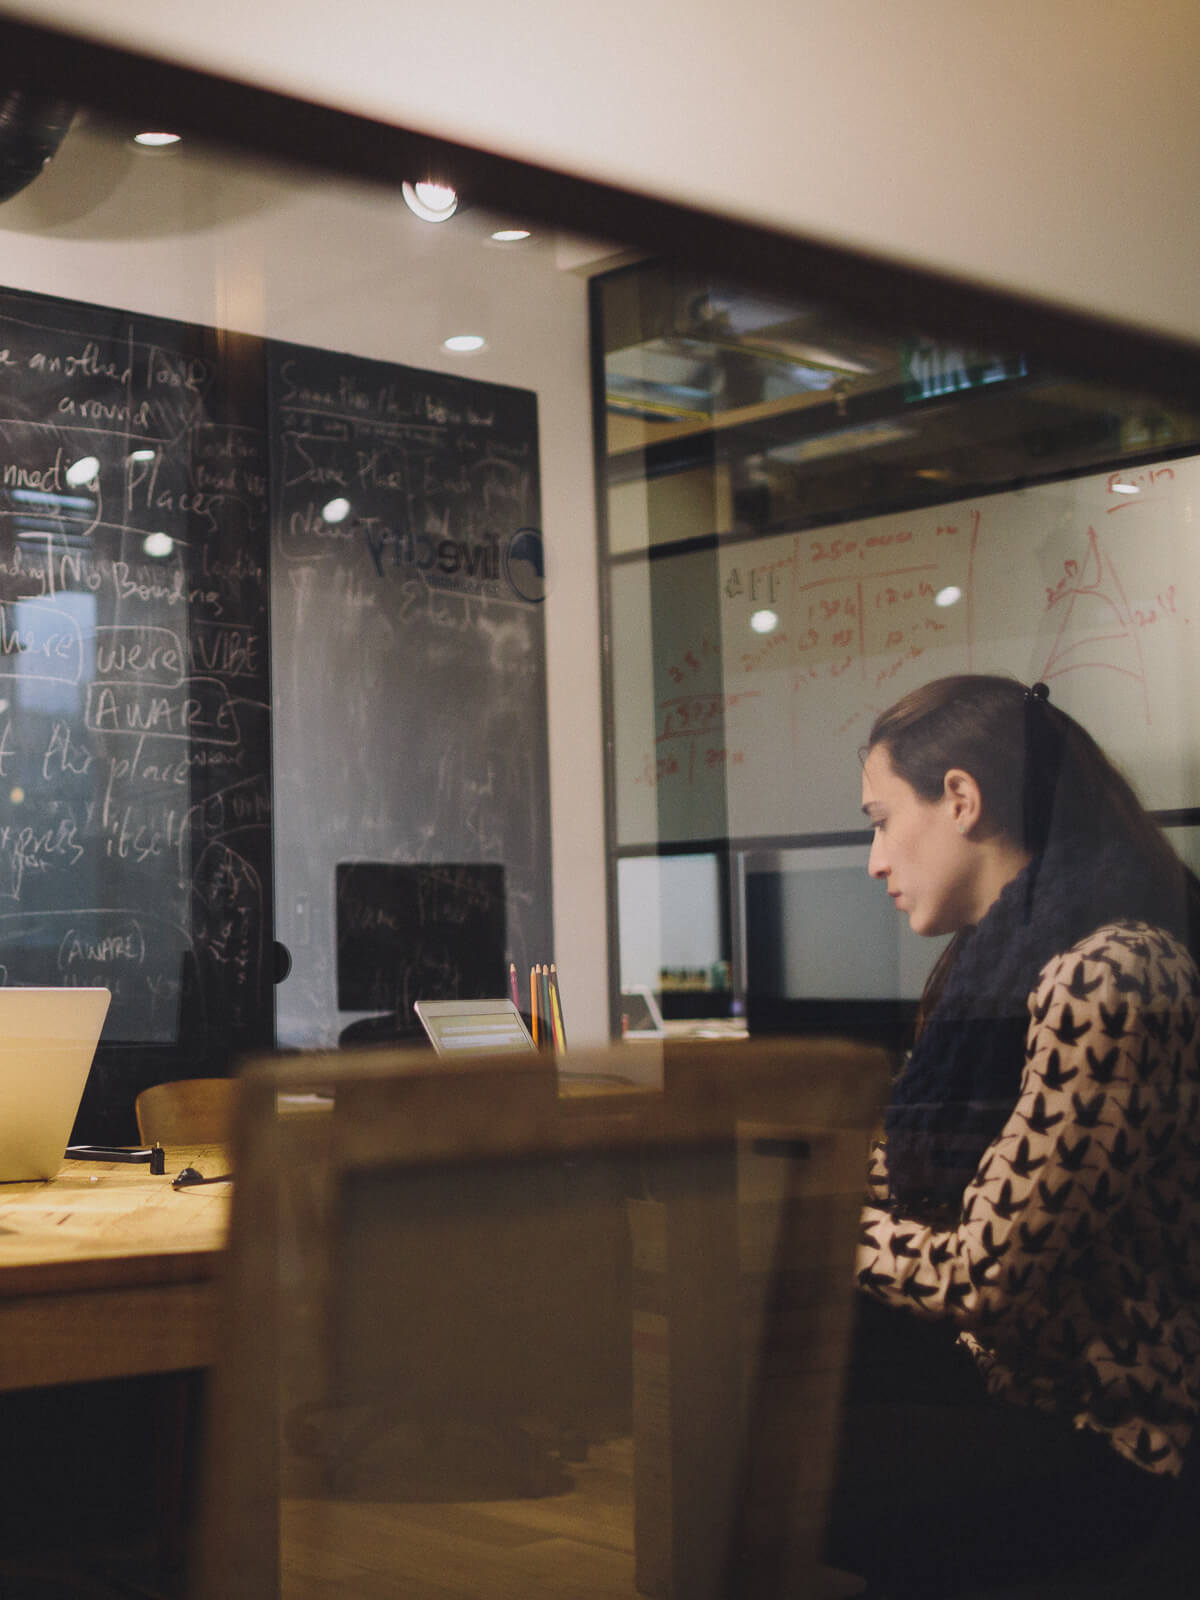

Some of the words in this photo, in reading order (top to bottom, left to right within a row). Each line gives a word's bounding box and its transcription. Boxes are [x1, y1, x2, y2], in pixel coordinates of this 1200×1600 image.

[28, 342, 131, 385] another
[57, 396, 151, 427] around
[96, 686, 235, 731] AWARE
